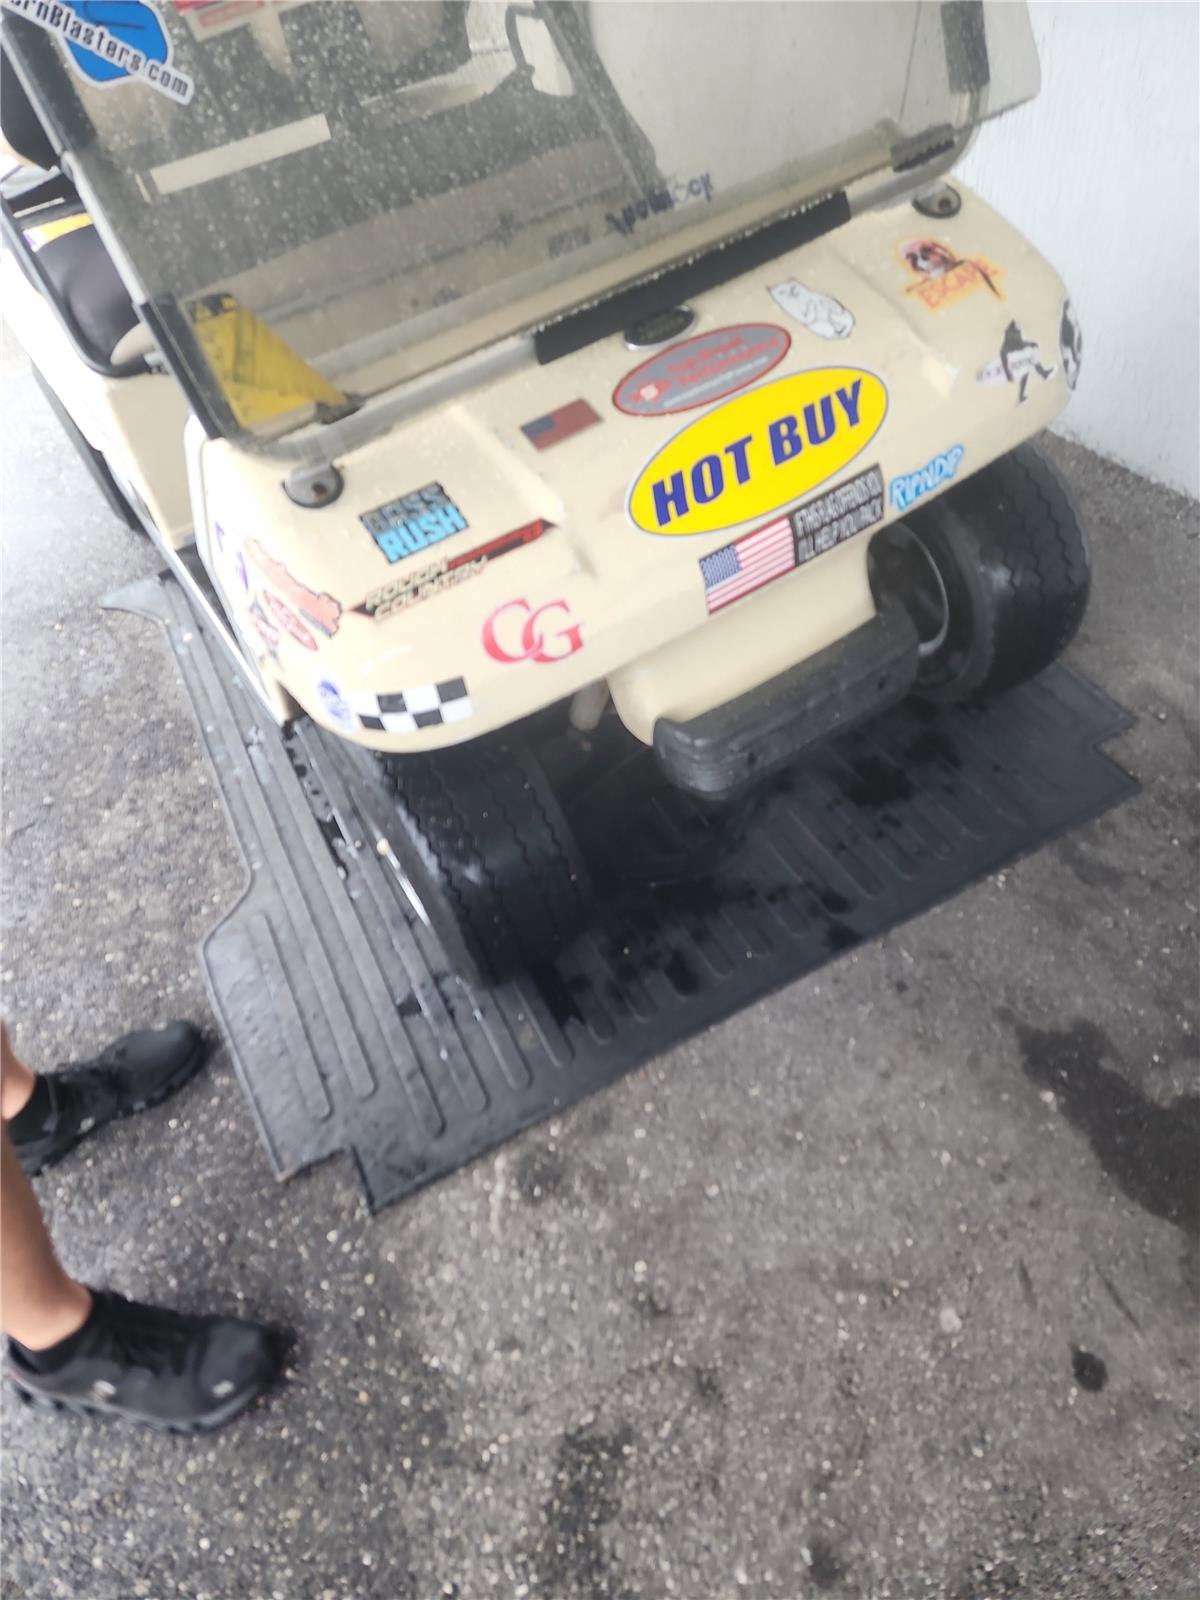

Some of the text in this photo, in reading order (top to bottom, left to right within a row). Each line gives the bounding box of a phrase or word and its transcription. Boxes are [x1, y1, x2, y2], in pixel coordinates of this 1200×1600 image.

[652, 434, 753, 527] HOT
[768, 377, 862, 467] BUY
[375, 502, 469, 563] RUSH
[481, 598, 584, 663] CG
